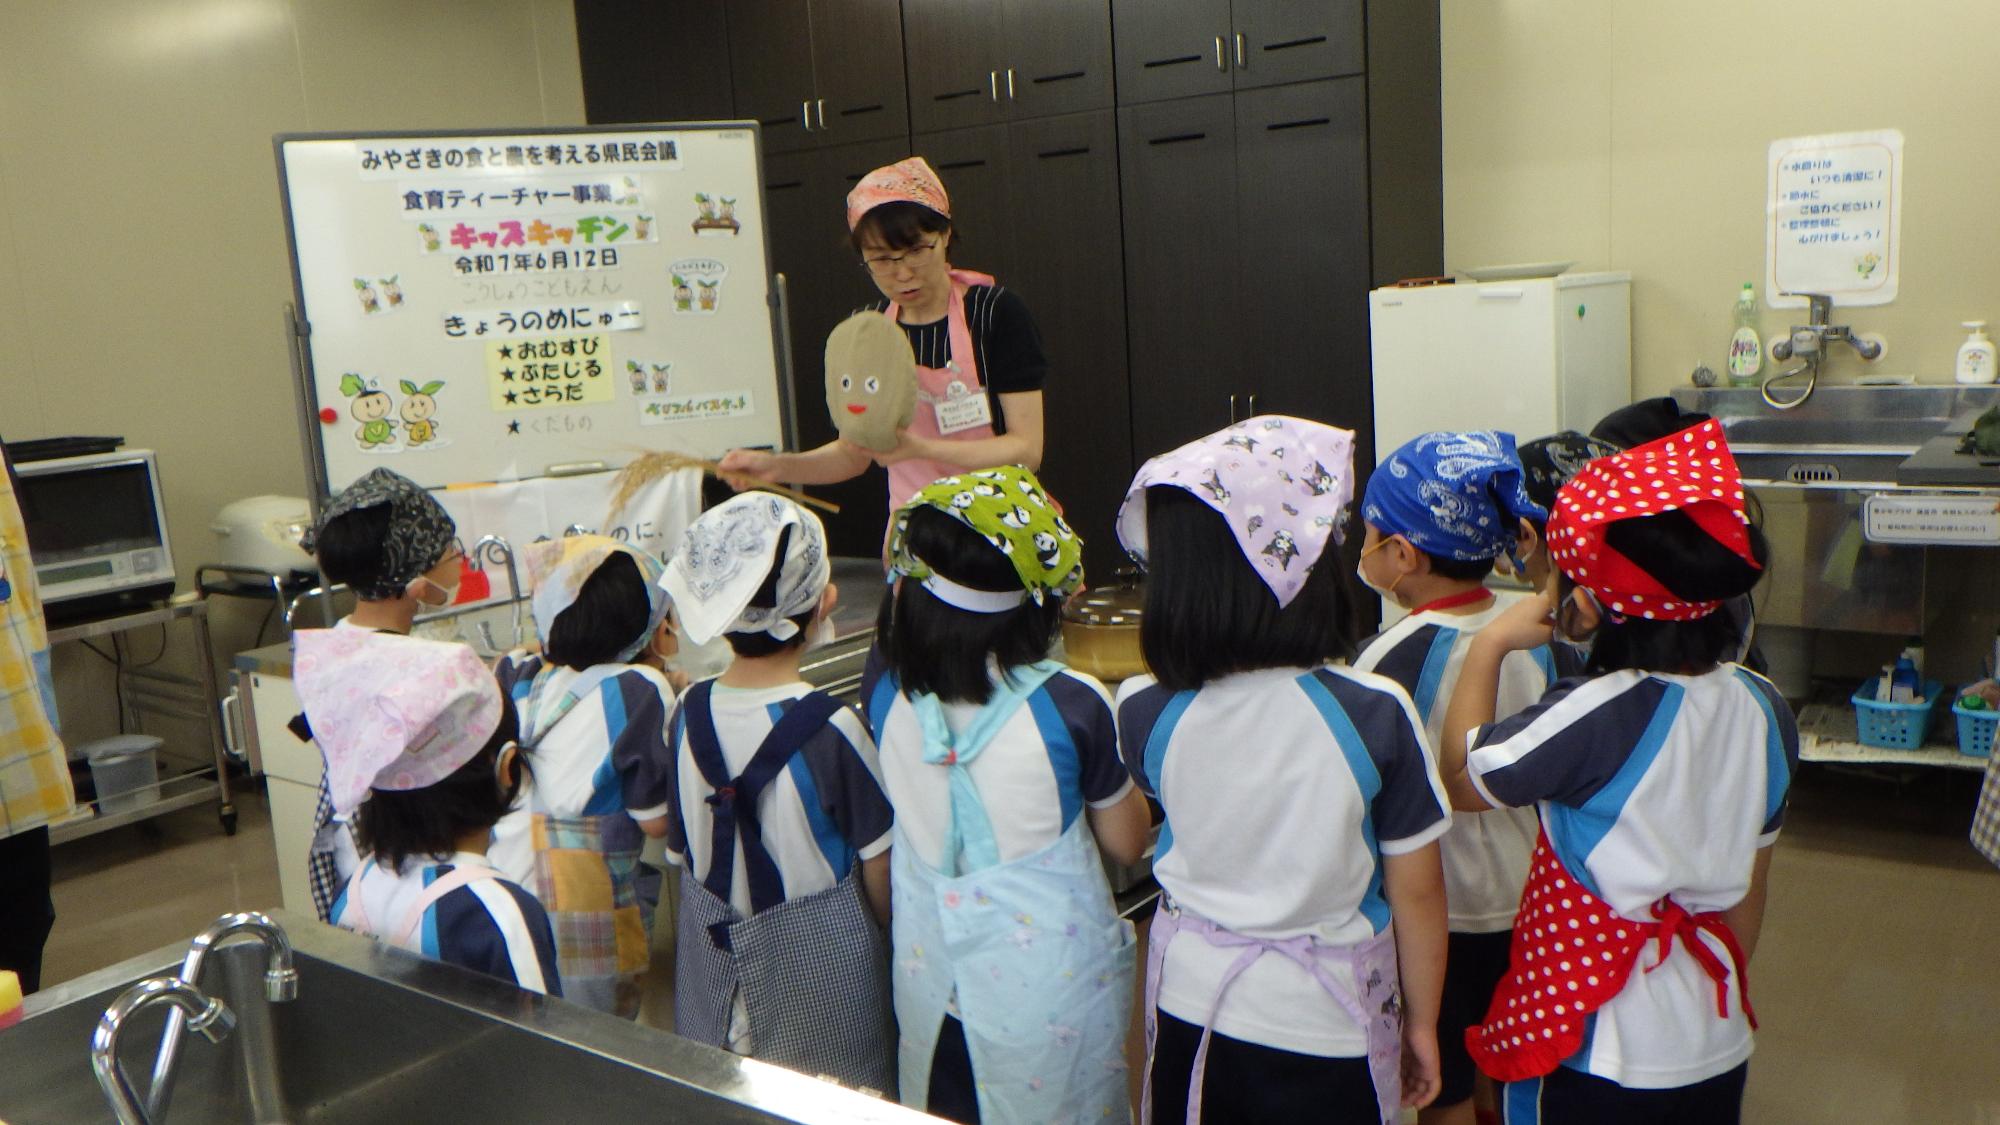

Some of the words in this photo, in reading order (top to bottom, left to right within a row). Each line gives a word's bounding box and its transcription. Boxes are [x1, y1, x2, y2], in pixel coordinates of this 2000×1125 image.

[361, 140, 678, 170] みやざきの食と農を考える県民会議
[402, 183, 613, 211] 食育ティーチャー事業
[449, 215, 630, 249] キッスキッチン
[455, 248, 618, 274] 令和7年6月12日
[444, 307, 640, 337] きょうのめにゅー
[517, 336, 600, 360] おむすび
[520, 359, 602, 382] ぶたじる
[522, 381, 585, 405] さらだ
[530, 415, 593, 434] くだもの
